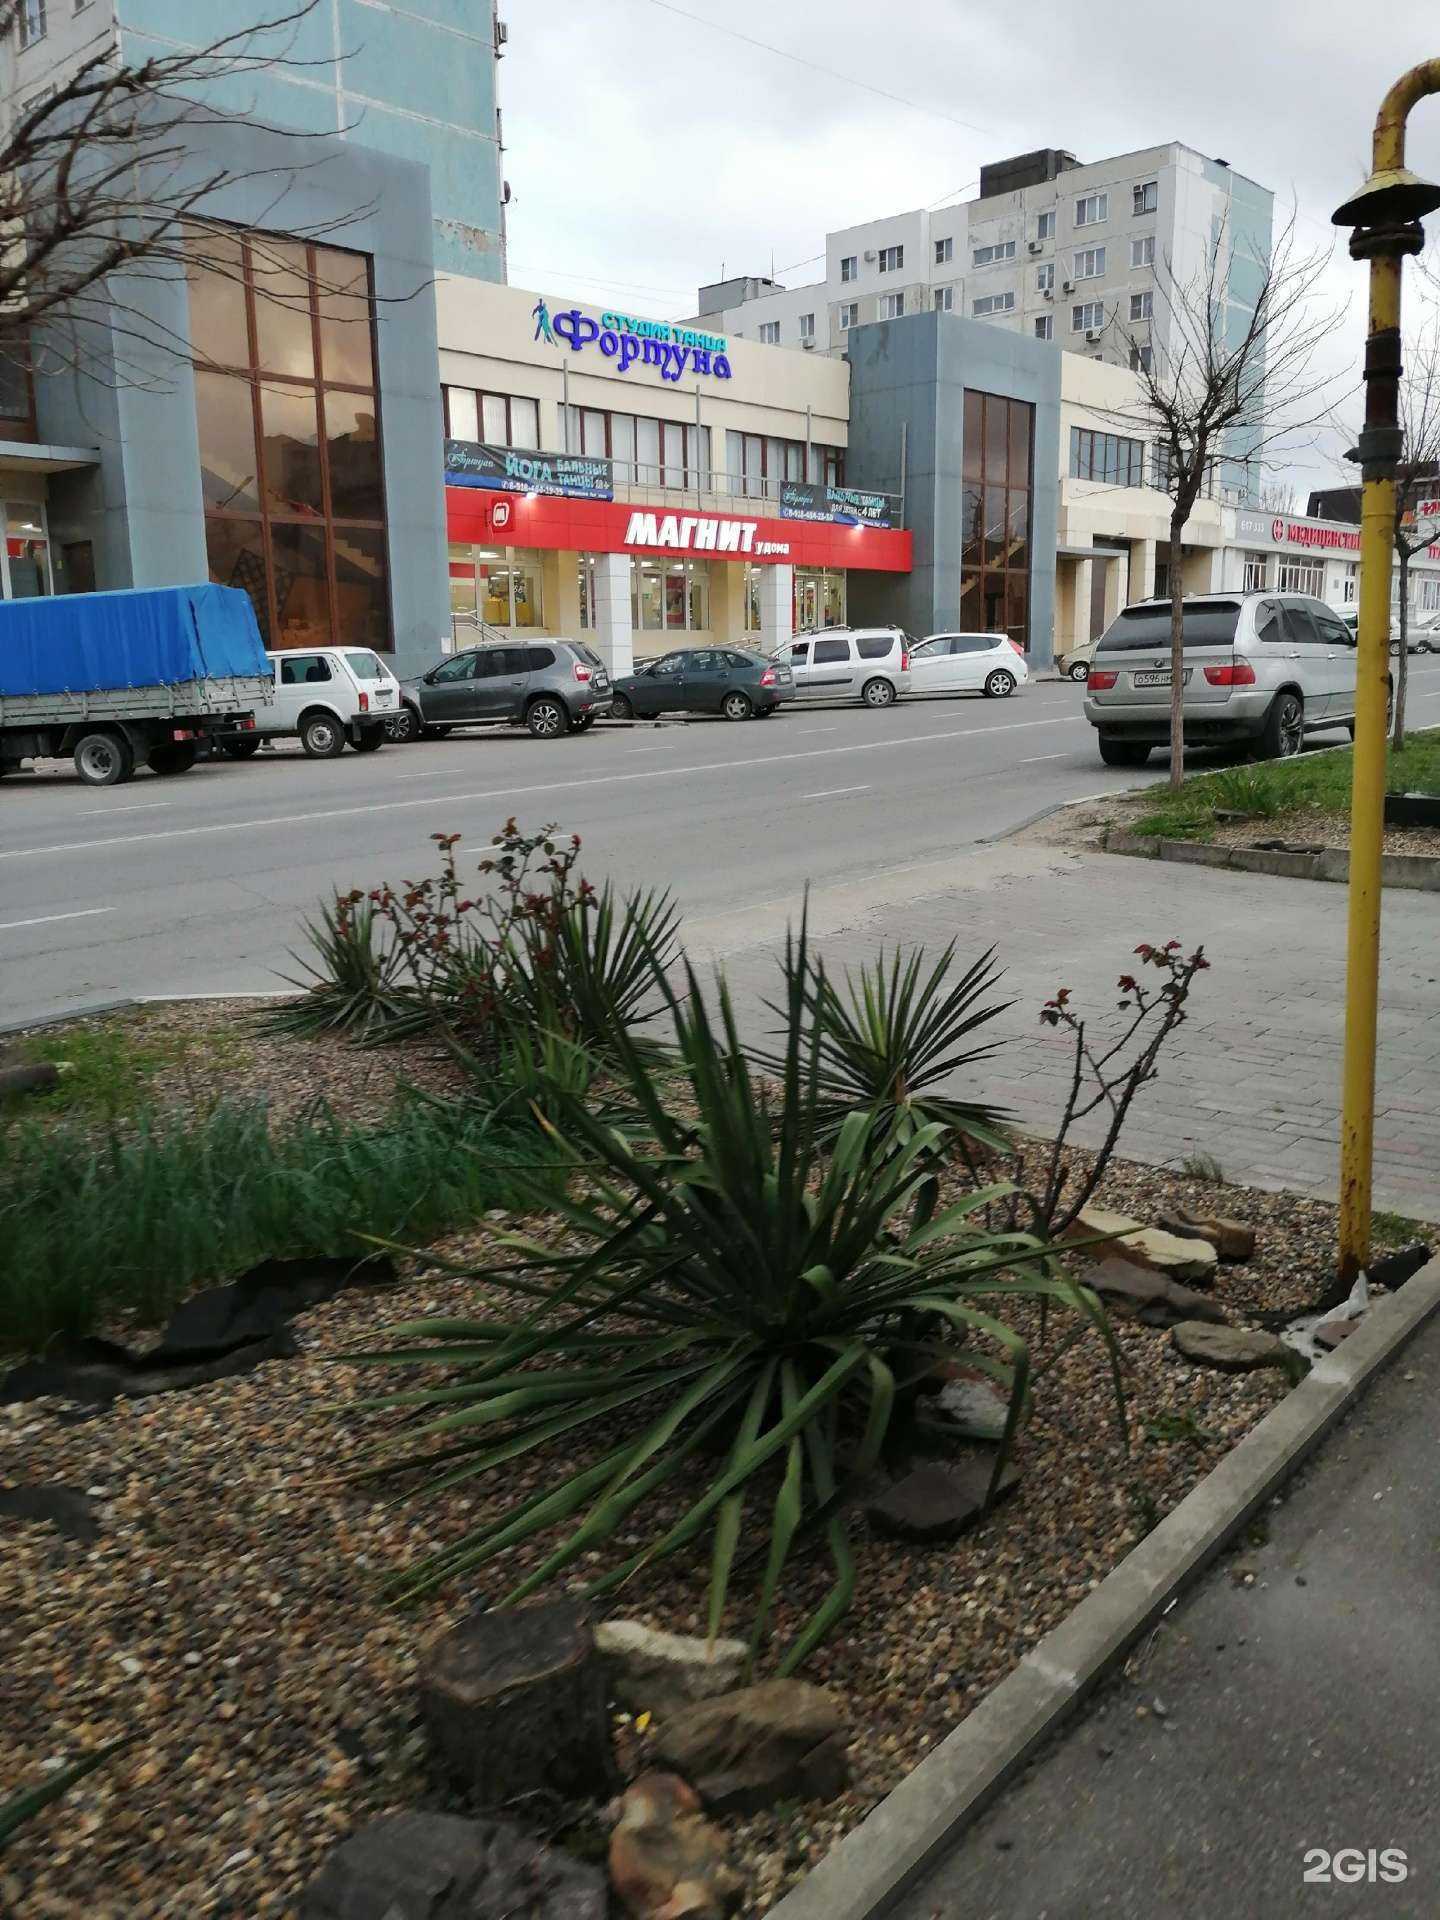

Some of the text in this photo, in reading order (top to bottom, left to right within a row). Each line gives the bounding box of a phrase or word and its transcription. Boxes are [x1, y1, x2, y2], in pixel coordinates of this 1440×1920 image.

[601, 312, 670, 340] СТУДИЯ
[553, 310, 731, 381] Фортуна
[505, 452, 553, 481] ЙОГА
[556, 459, 608, 476] БАЛЬНЫЕ
[557, 473, 594, 489] ТАНЦЫ
[868, 507, 882, 518] ЛЕТ
[624, 512, 757, 552] МАГНИТ
